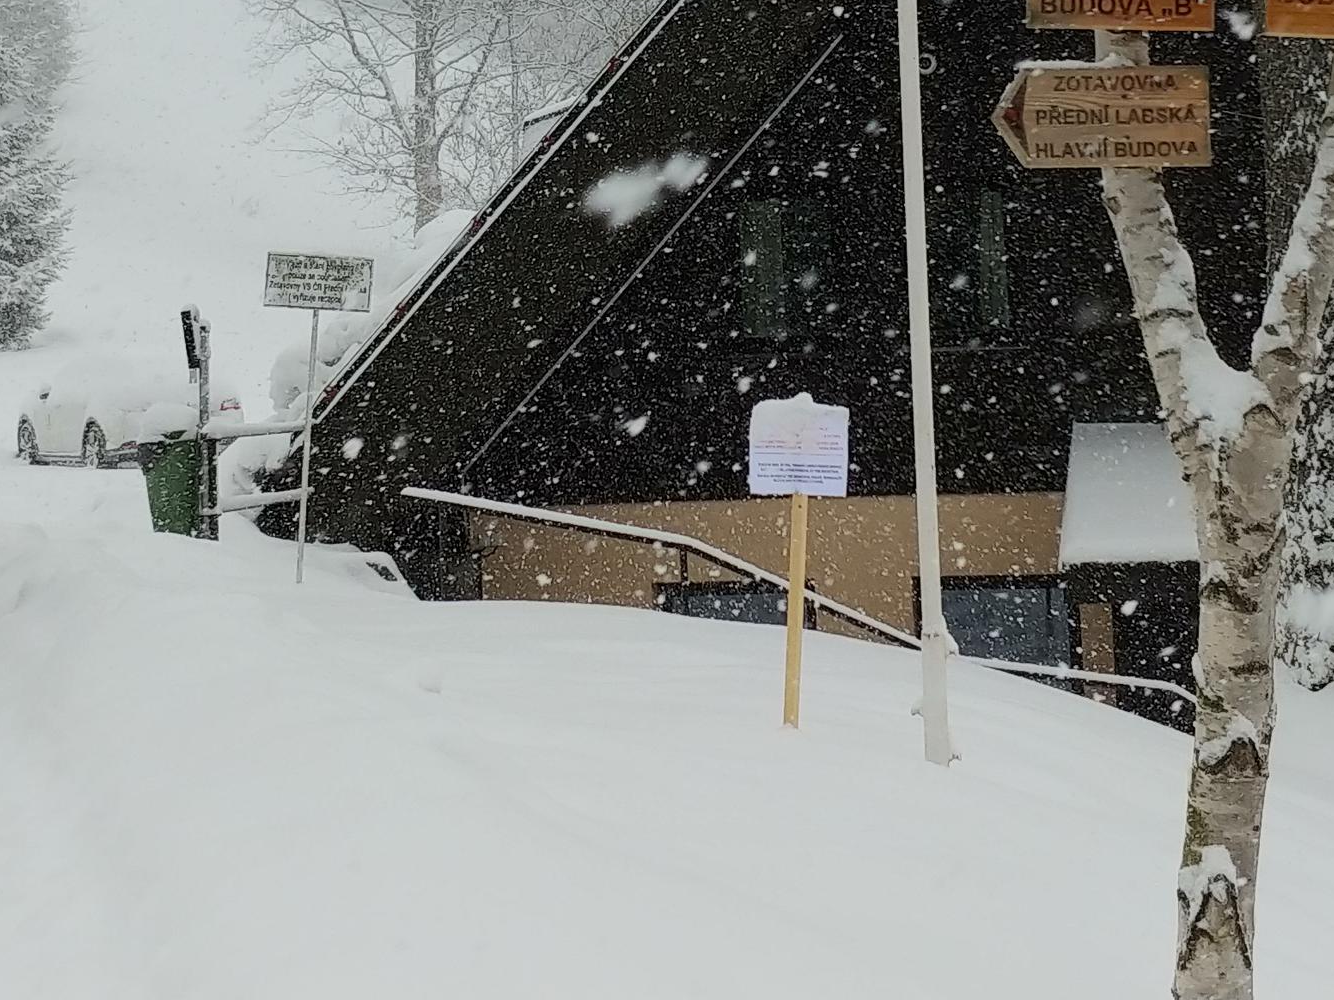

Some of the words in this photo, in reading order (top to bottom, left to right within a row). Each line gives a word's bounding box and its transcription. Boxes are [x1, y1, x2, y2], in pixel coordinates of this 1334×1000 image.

[1053, 74, 1178, 92] ZOTAVOVNA
[1035, 104, 1110, 126] PŘEDNÍ
[1115, 103, 1197, 125] LABSKÁ
[1035, 137, 1108, 159] HLAVNÍ
[1115, 141, 1199, 158] BUDOVA
